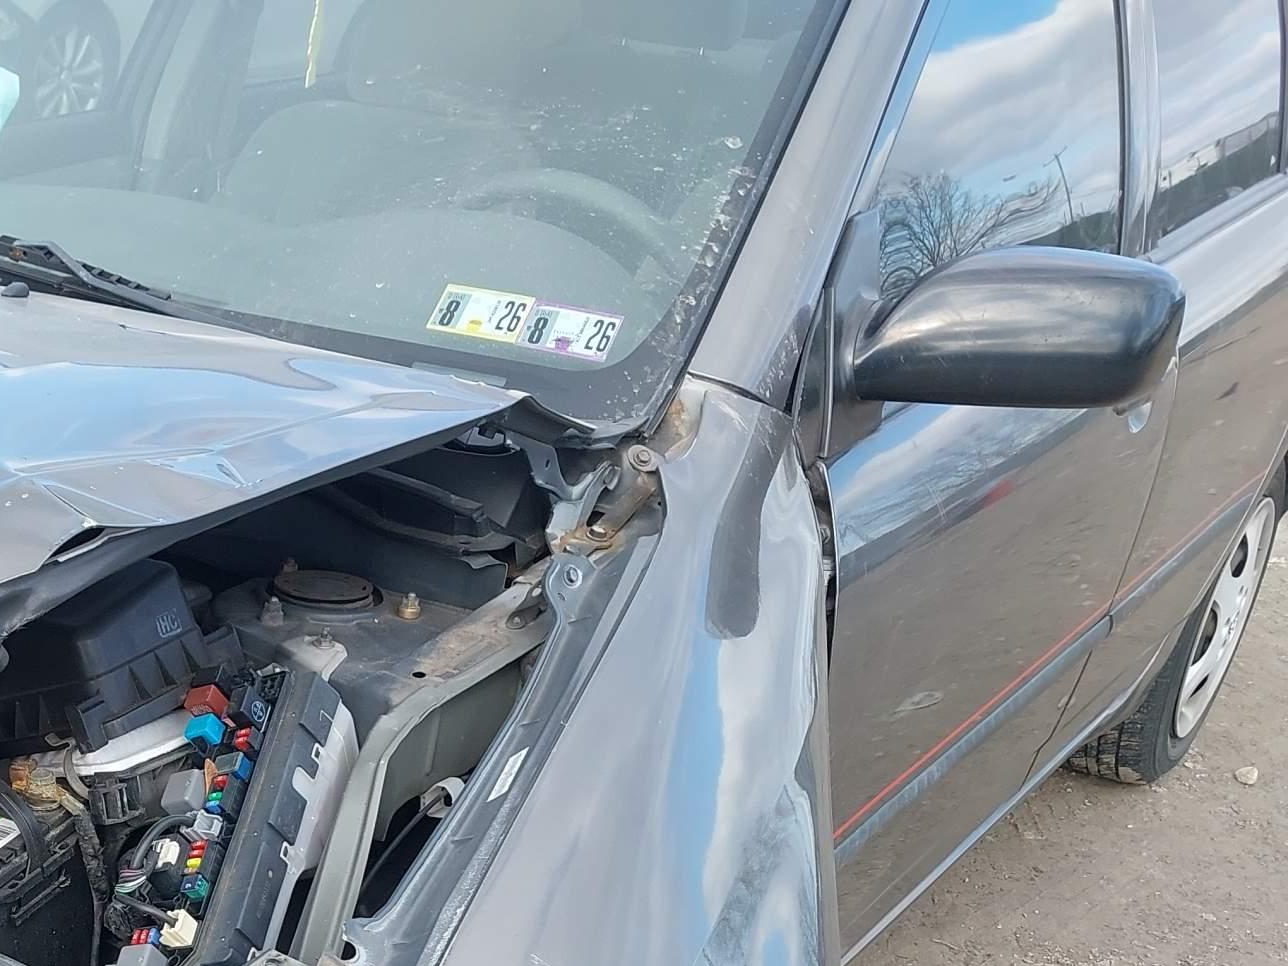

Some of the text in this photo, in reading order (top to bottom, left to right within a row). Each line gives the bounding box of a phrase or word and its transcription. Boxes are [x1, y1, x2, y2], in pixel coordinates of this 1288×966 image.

[438, 300, 461, 326] 8
[495, 301, 527, 332] 26
[527, 317, 549, 344] 8
[584, 319, 616, 352] 26
